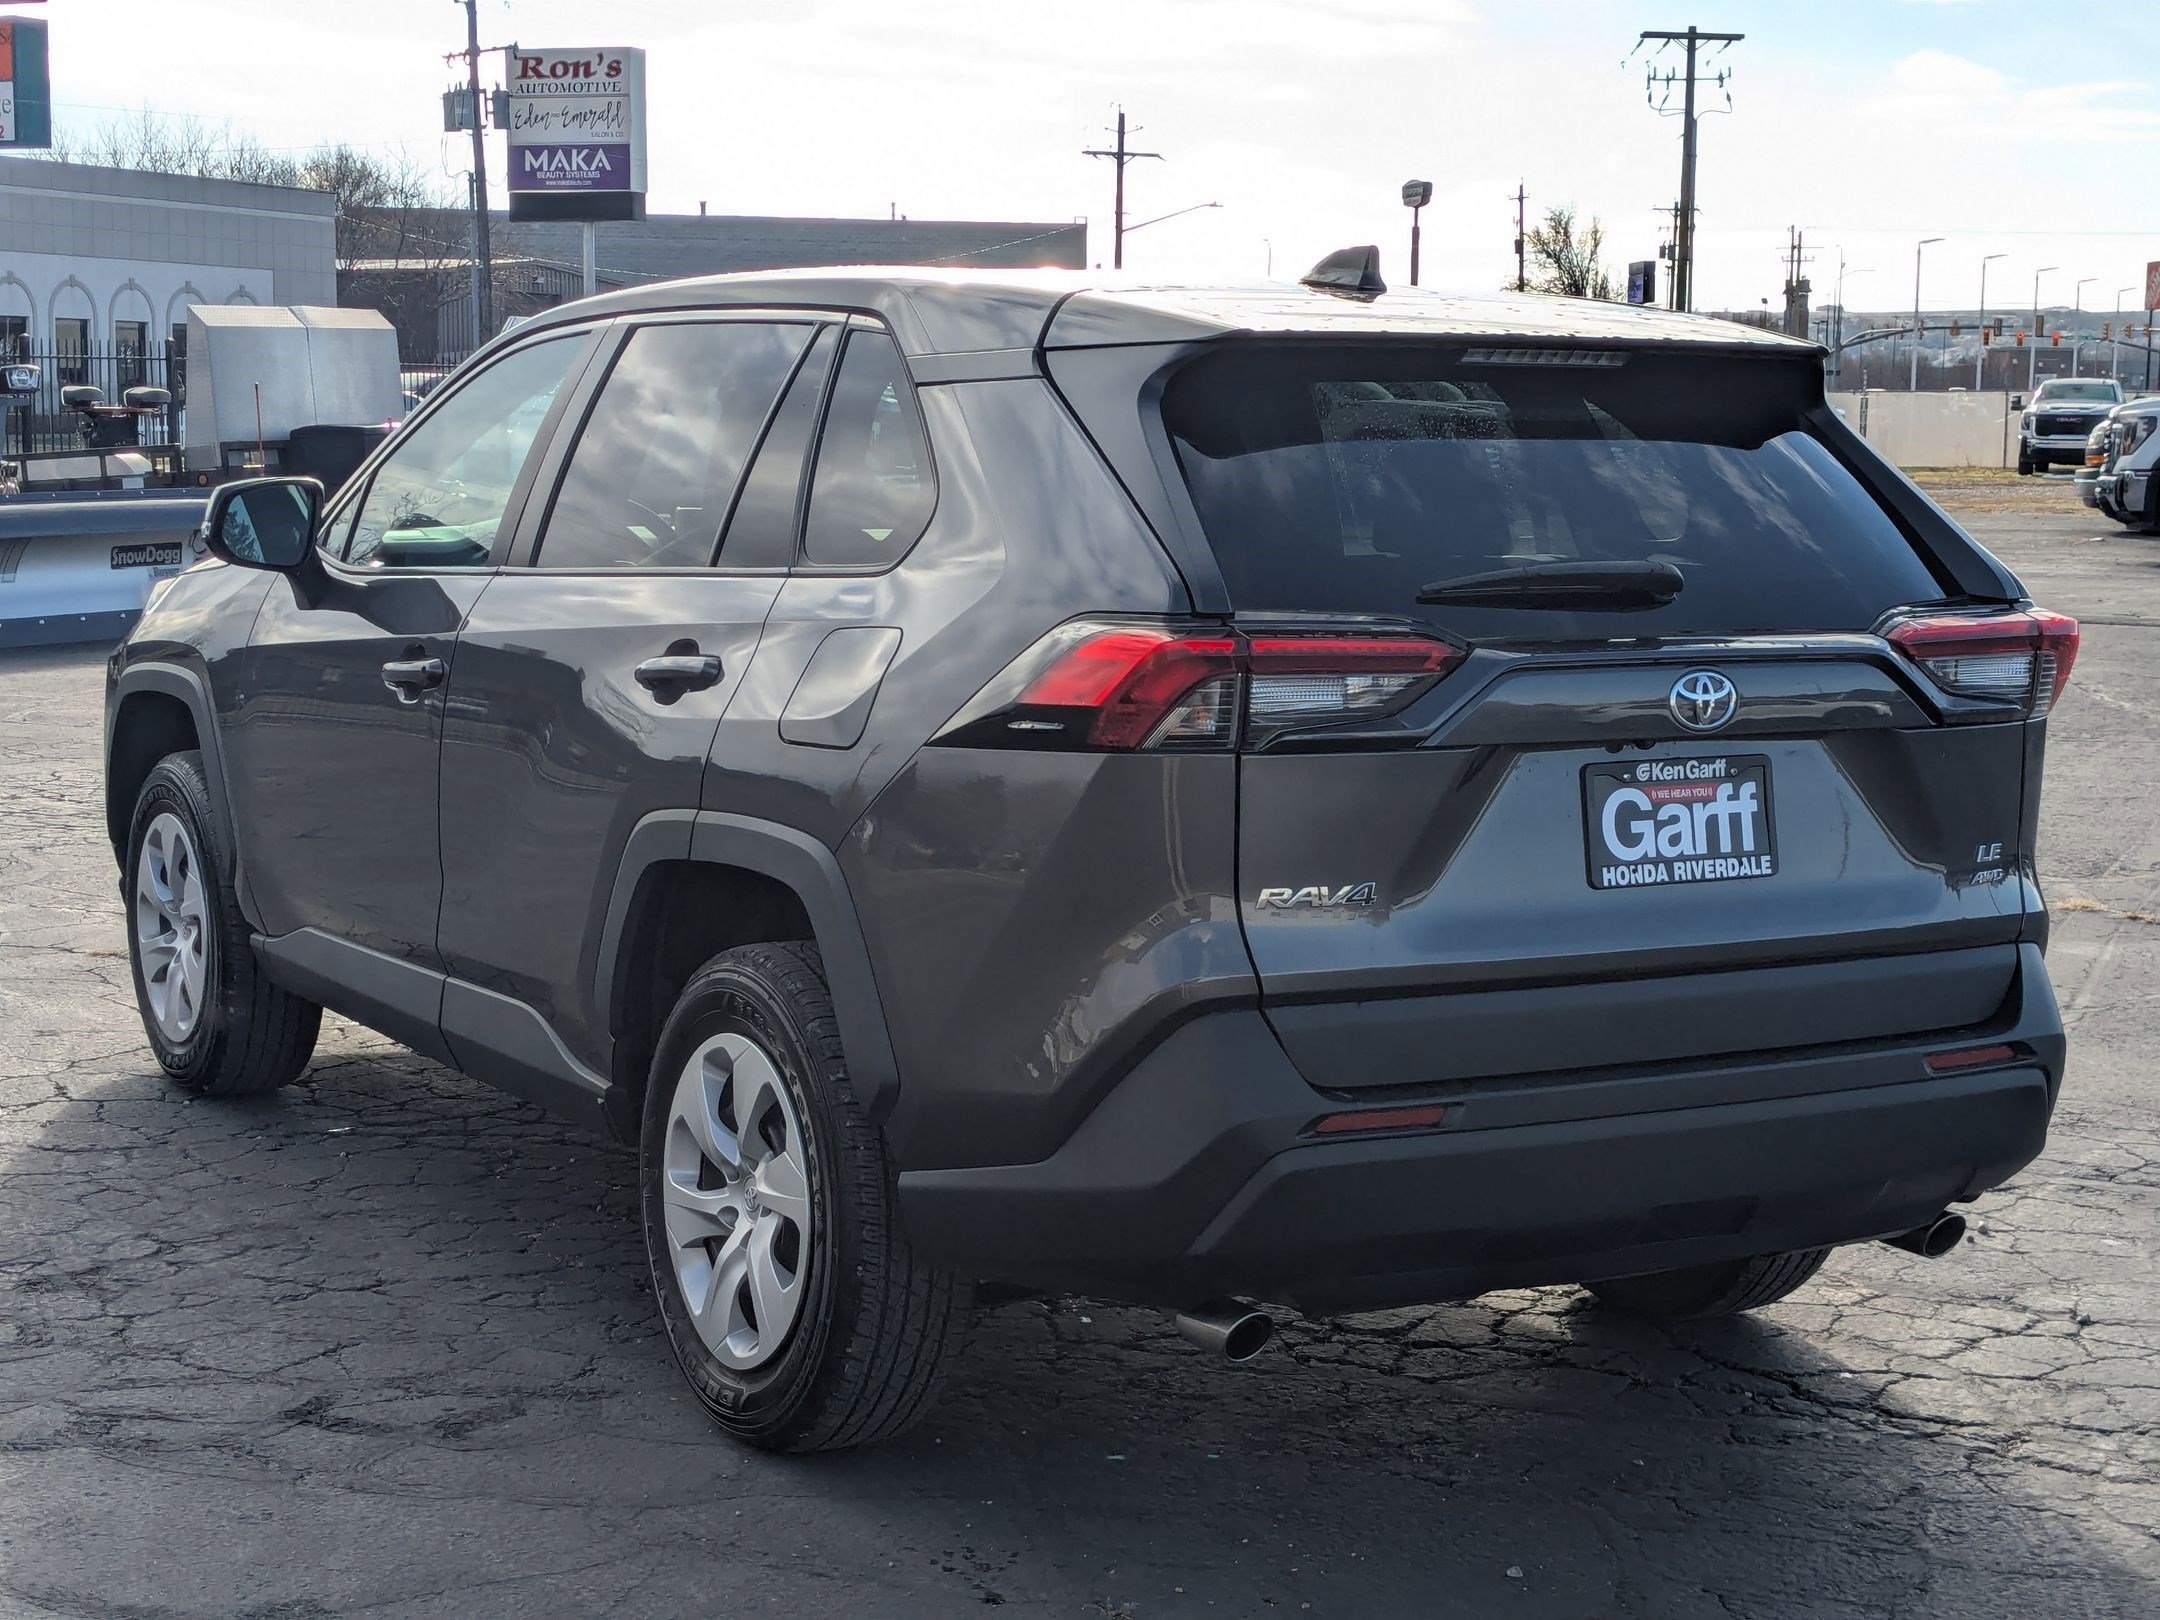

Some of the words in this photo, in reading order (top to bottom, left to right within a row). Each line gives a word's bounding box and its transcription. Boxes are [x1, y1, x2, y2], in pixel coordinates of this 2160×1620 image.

[515, 53, 623, 80] Ron's
[515, 82, 621, 94] AUTOMOTIVE
[514, 102, 551, 130] Eden
[561, 101, 624, 130] Emerald
[524, 148, 612, 171] MAKA
[536, 171, 565, 179] BEAUTY
[566, 170, 601, 178] SYSTEMS
[112, 545, 182, 566] SnowDogg
[1651, 761, 1685, 781] Ken
[1686, 758, 1727, 778] Garff
[1657, 789, 1670, 798] WE
[1670, 788, 1692, 798] HEAR
[1692, 787, 1708, 797] YOU
[1602, 781, 1758, 861] Garff
[1976, 843, 2002, 862] LE
[1602, 863, 1669, 886] HONDA
[1673, 855, 1772, 881] RIVERDALE
[1971, 868, 2003, 885] AWD
[1256, 882, 1377, 909] RAV4
